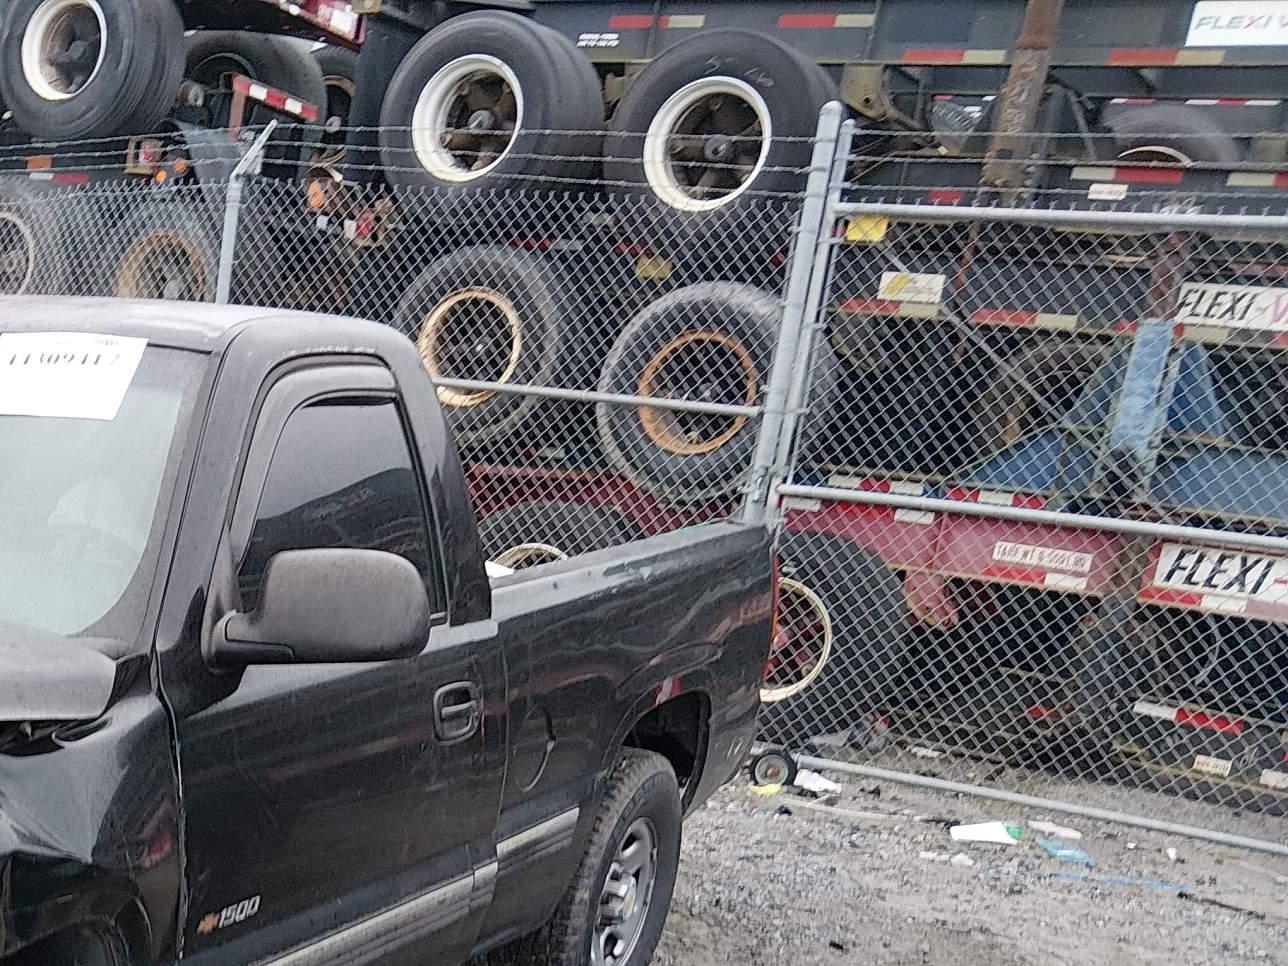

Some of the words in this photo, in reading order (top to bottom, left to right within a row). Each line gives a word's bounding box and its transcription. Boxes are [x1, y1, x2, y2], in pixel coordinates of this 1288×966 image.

[1193, 15, 1273, 31] FLEXI
[1176, 288, 1259, 321] FLEXI
[1162, 548, 1276, 594] FLEXI
[218, 895, 261, 928] 1500
